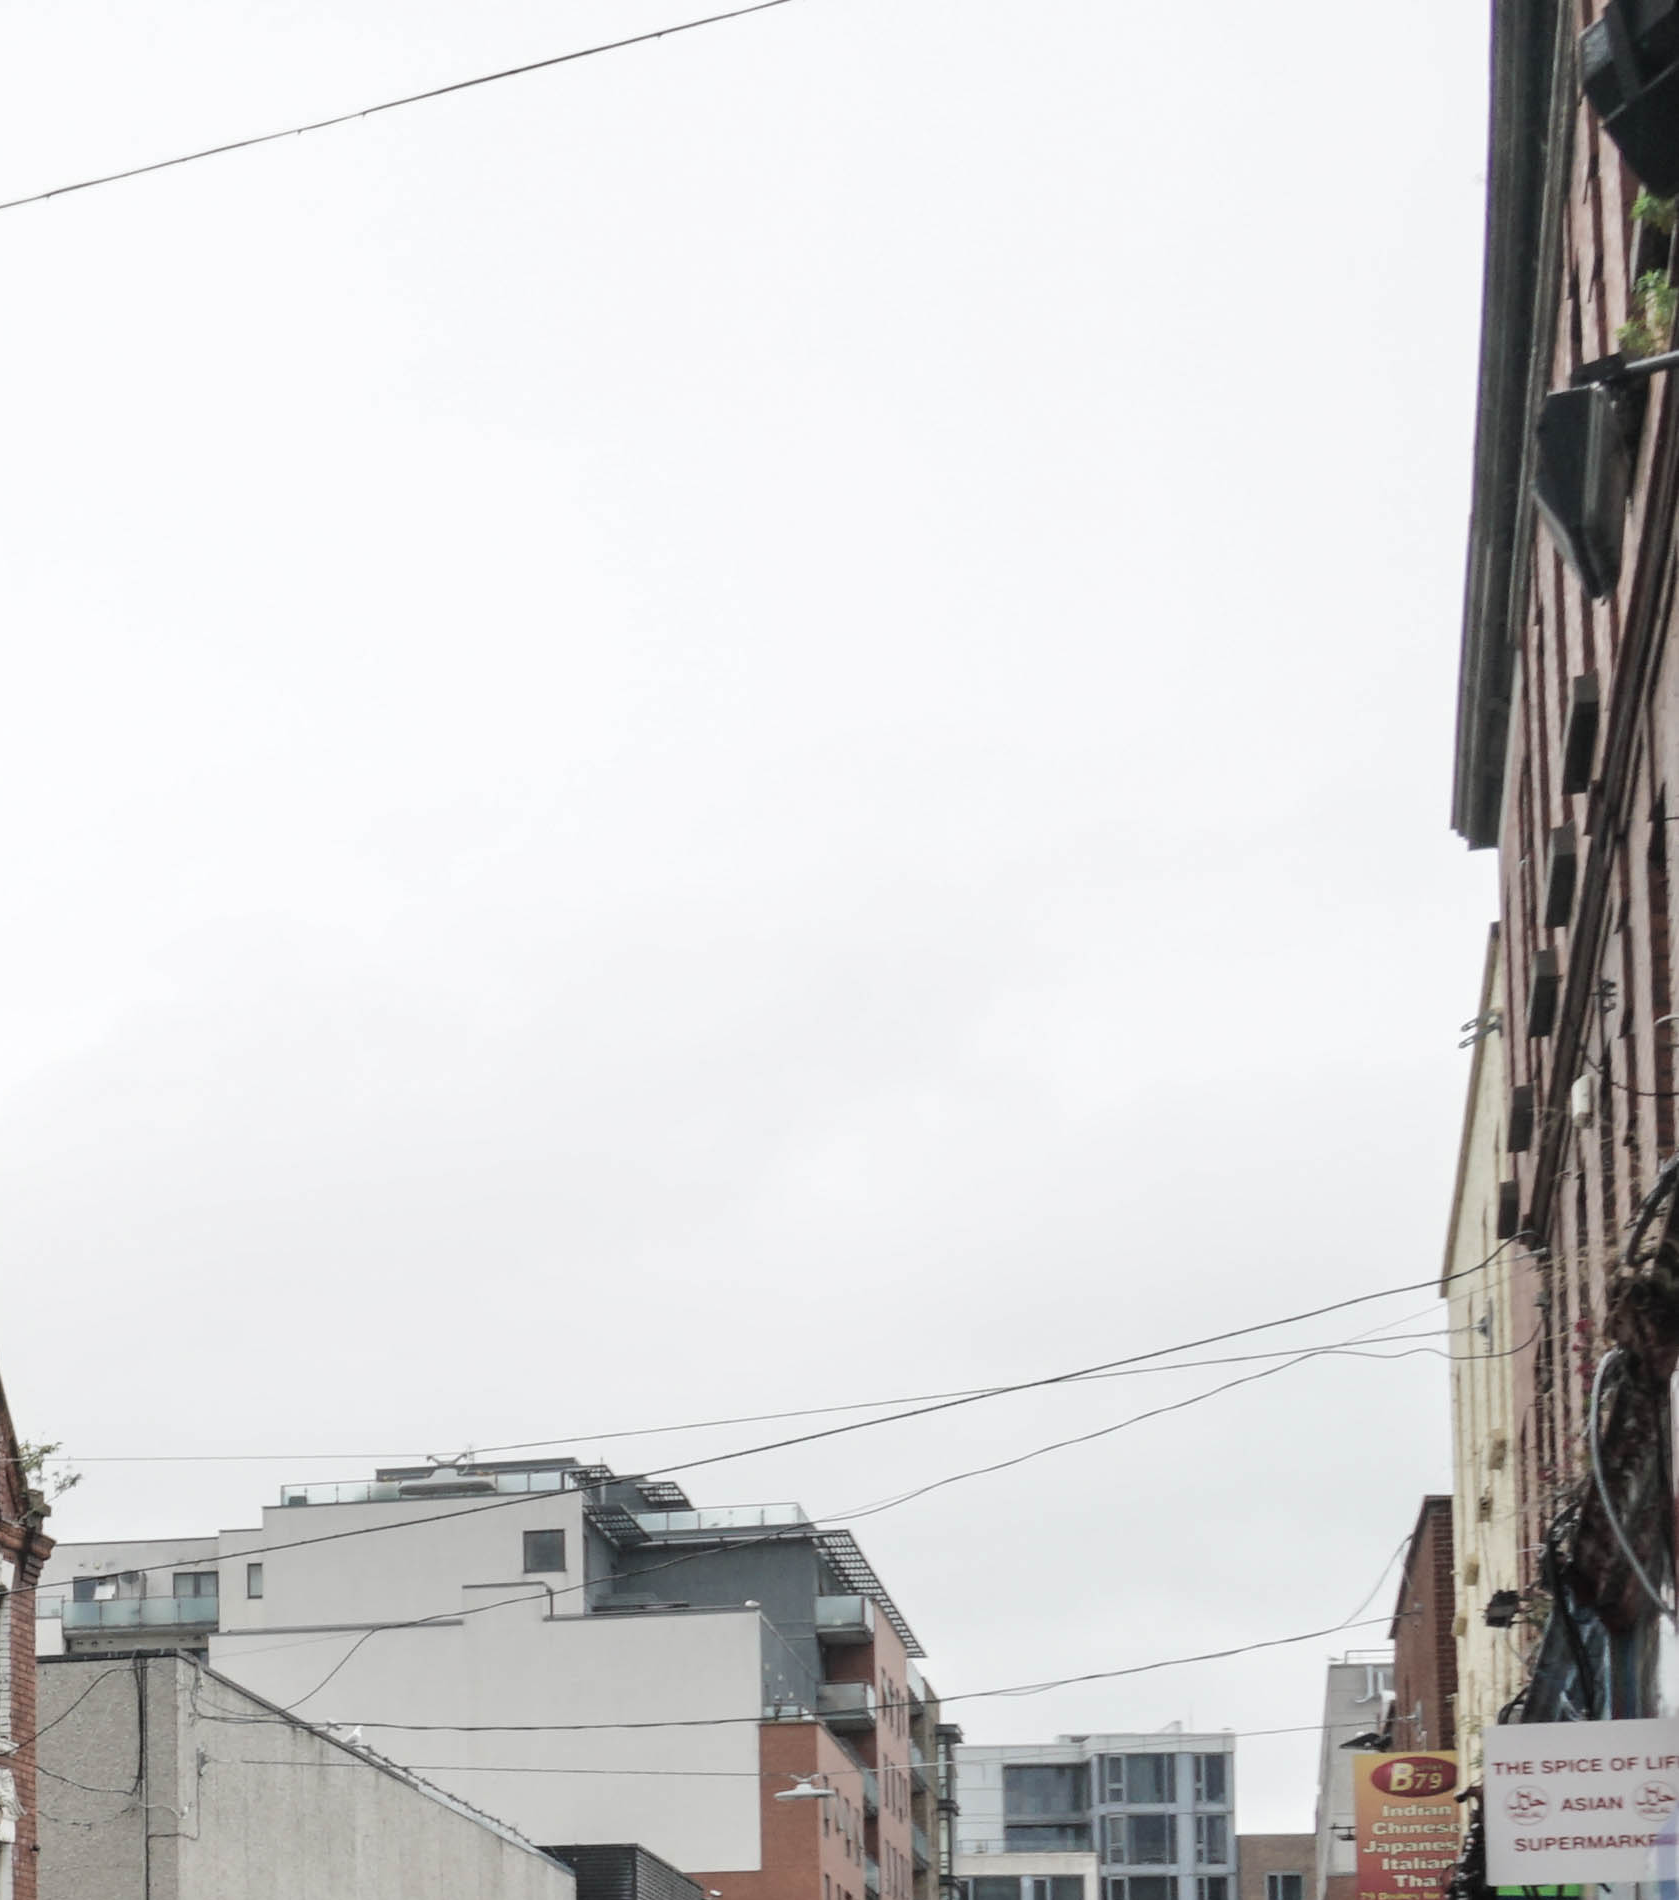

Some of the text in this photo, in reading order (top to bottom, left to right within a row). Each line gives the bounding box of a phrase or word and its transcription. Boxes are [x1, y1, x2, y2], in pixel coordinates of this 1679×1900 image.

[1491, 1760, 1534, 1775] THE
[1541, 1758, 1604, 1775] SPICE
[1610, 1756, 1639, 1772] OF
[1382, 1804, 1453, 1818] Indian
[1560, 1795, 1624, 1812] ASIAN
